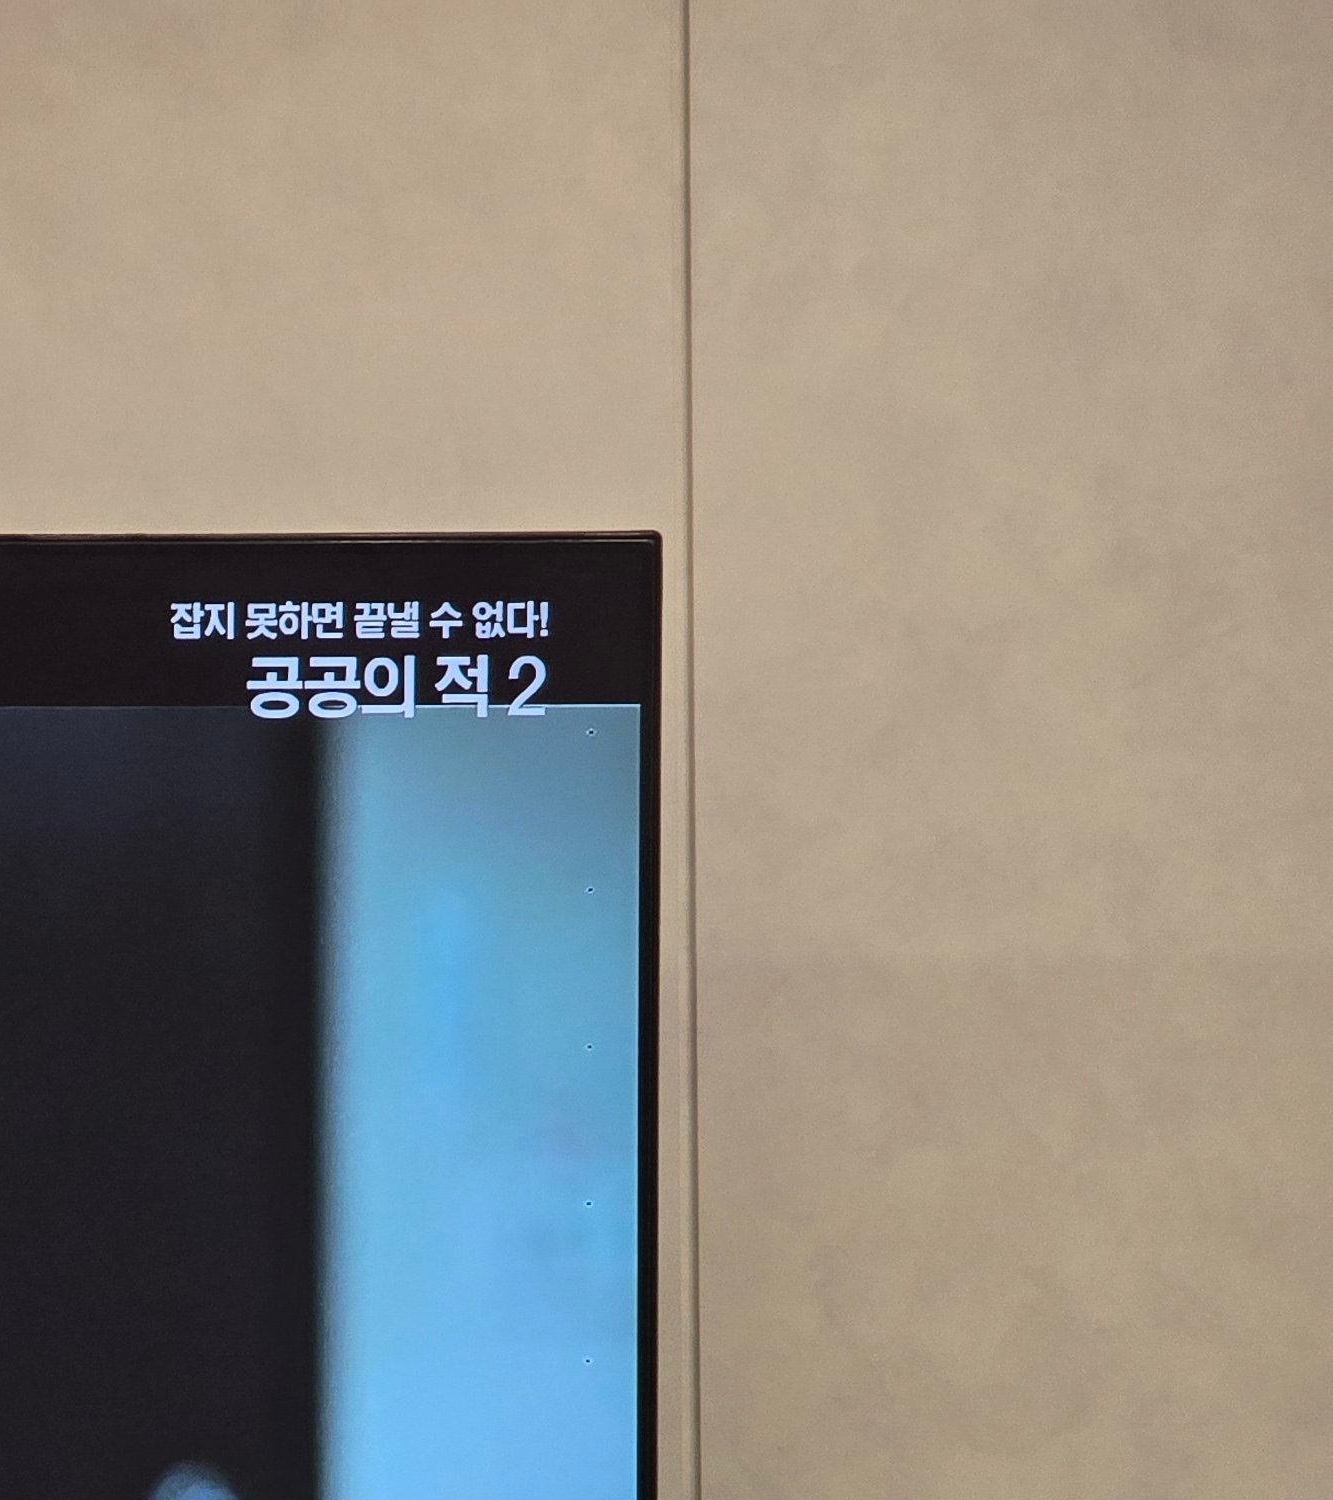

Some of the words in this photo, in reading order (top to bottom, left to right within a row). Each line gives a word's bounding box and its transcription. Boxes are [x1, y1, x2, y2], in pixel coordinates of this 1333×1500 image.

[170, 602, 235, 639] 잡지
[245, 602, 344, 639] 못하면
[353, 602, 420, 639] 끝낼
[429, 602, 463, 639] 수
[472, 602, 549, 639] 없다!
[246, 654, 415, 718] 공공의
[434, 654, 489, 718] 적
[507, 655, 546, 716] 2
